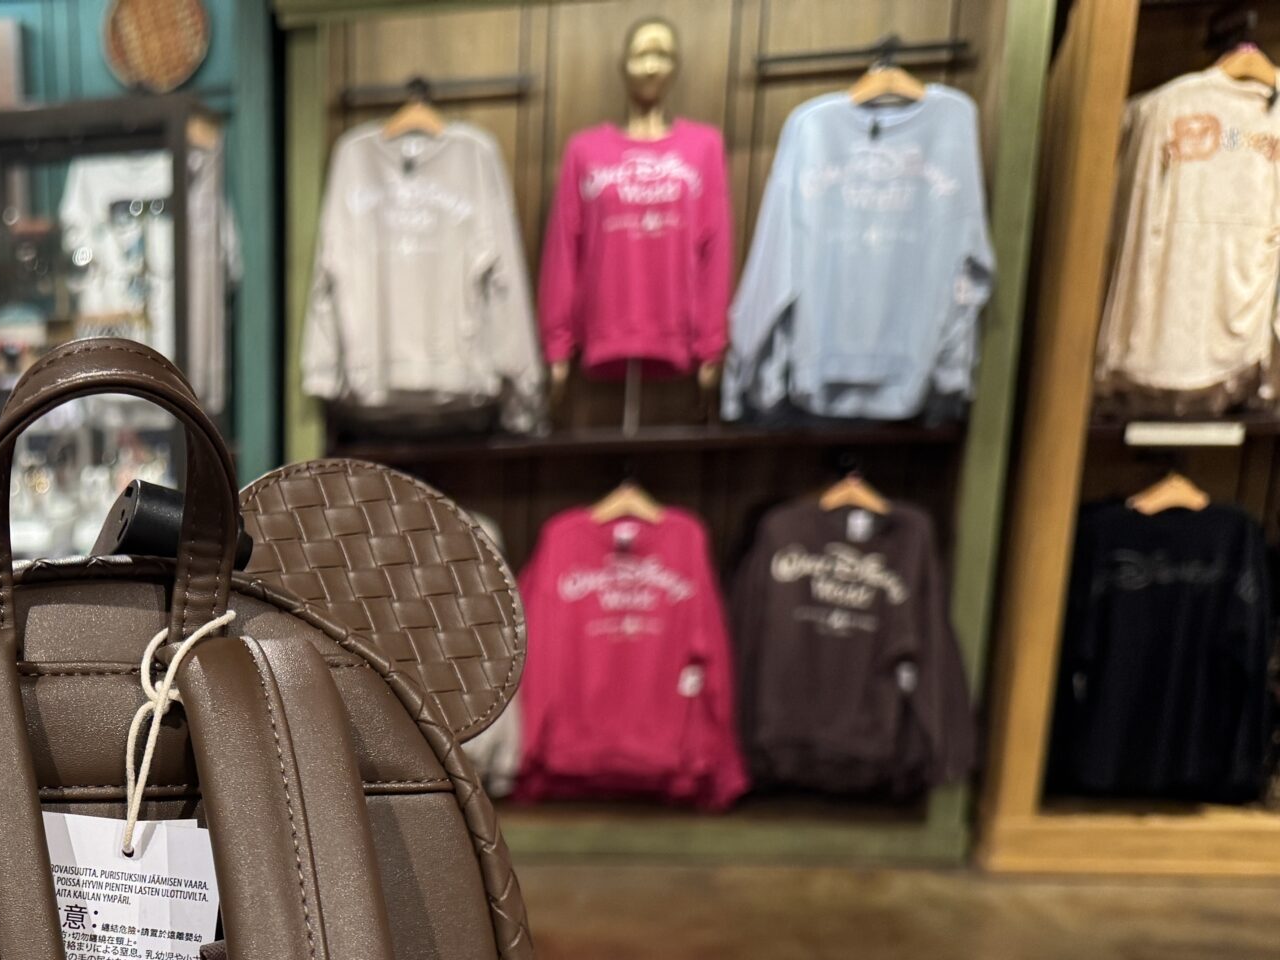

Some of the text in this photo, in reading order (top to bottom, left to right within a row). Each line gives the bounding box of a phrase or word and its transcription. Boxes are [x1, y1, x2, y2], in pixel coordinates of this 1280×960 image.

[56, 877, 209, 902] POISSA HYVIN PIENTEN LASTEN ULOTTUVILTA.
[100, 870, 147, 884] PURISTUKSIIN
[148, 874, 182, 887] JÄÄMISEN
[184, 879, 209, 890] VAARA.
[73, 890, 101, 901] KAULAN
[103, 893, 132, 905] YMPÄRI.
